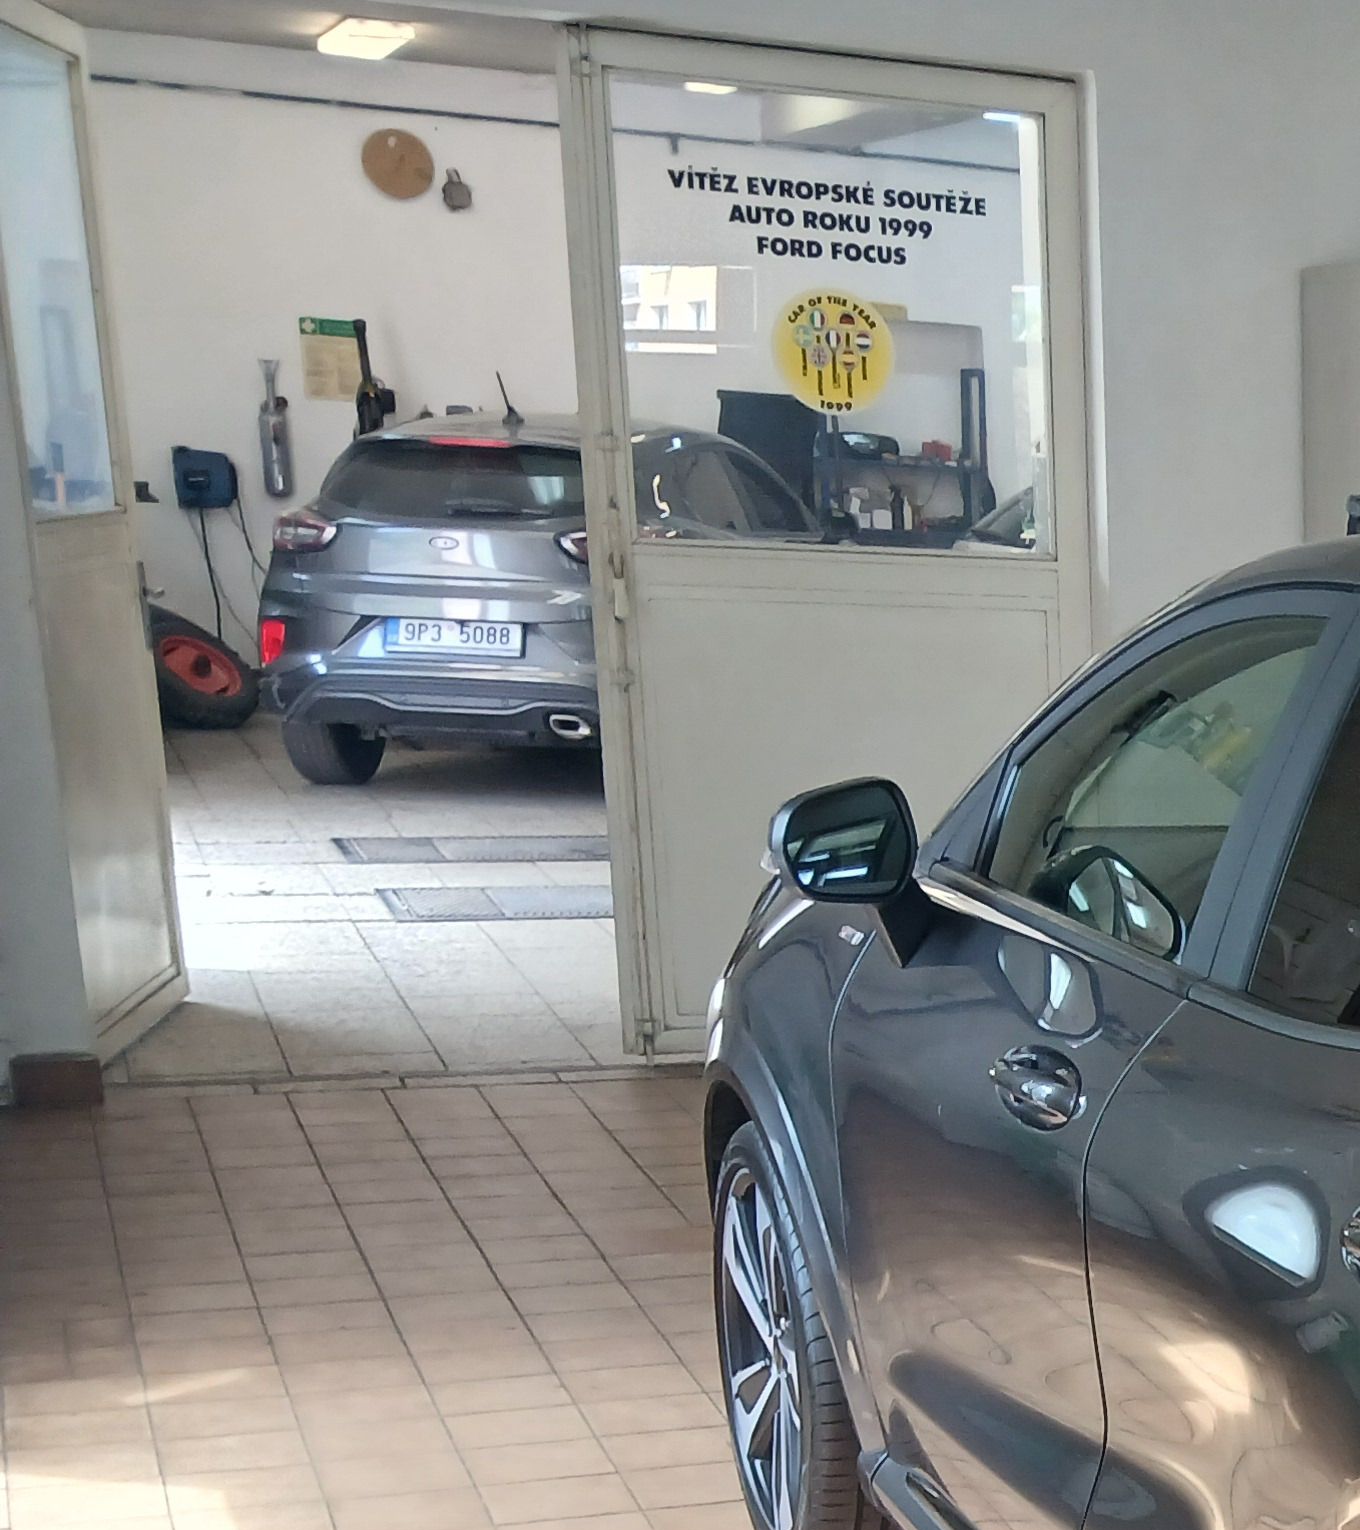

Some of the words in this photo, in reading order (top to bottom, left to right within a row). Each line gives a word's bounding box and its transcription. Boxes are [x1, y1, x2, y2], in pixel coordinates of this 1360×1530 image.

[667, 165, 738, 194] VÍTĚZ
[747, 176, 875, 206] EVROPSKÉ
[883, 188, 986, 217] SOUTĚŽE
[729, 204, 795, 228] AUTO
[802, 210, 870, 234] ROKU
[878, 216, 933, 240] 1999
[756, 236, 823, 259] FORD
[831, 241, 906, 265] FOCUS
[788, 304, 805, 324] CAR
[808, 296, 822, 307] OF
[827, 295, 848, 307] THE
[852, 303, 877, 329] YEAR
[404, 622, 442, 642] 9P3
[459, 625, 511, 645] 5088
